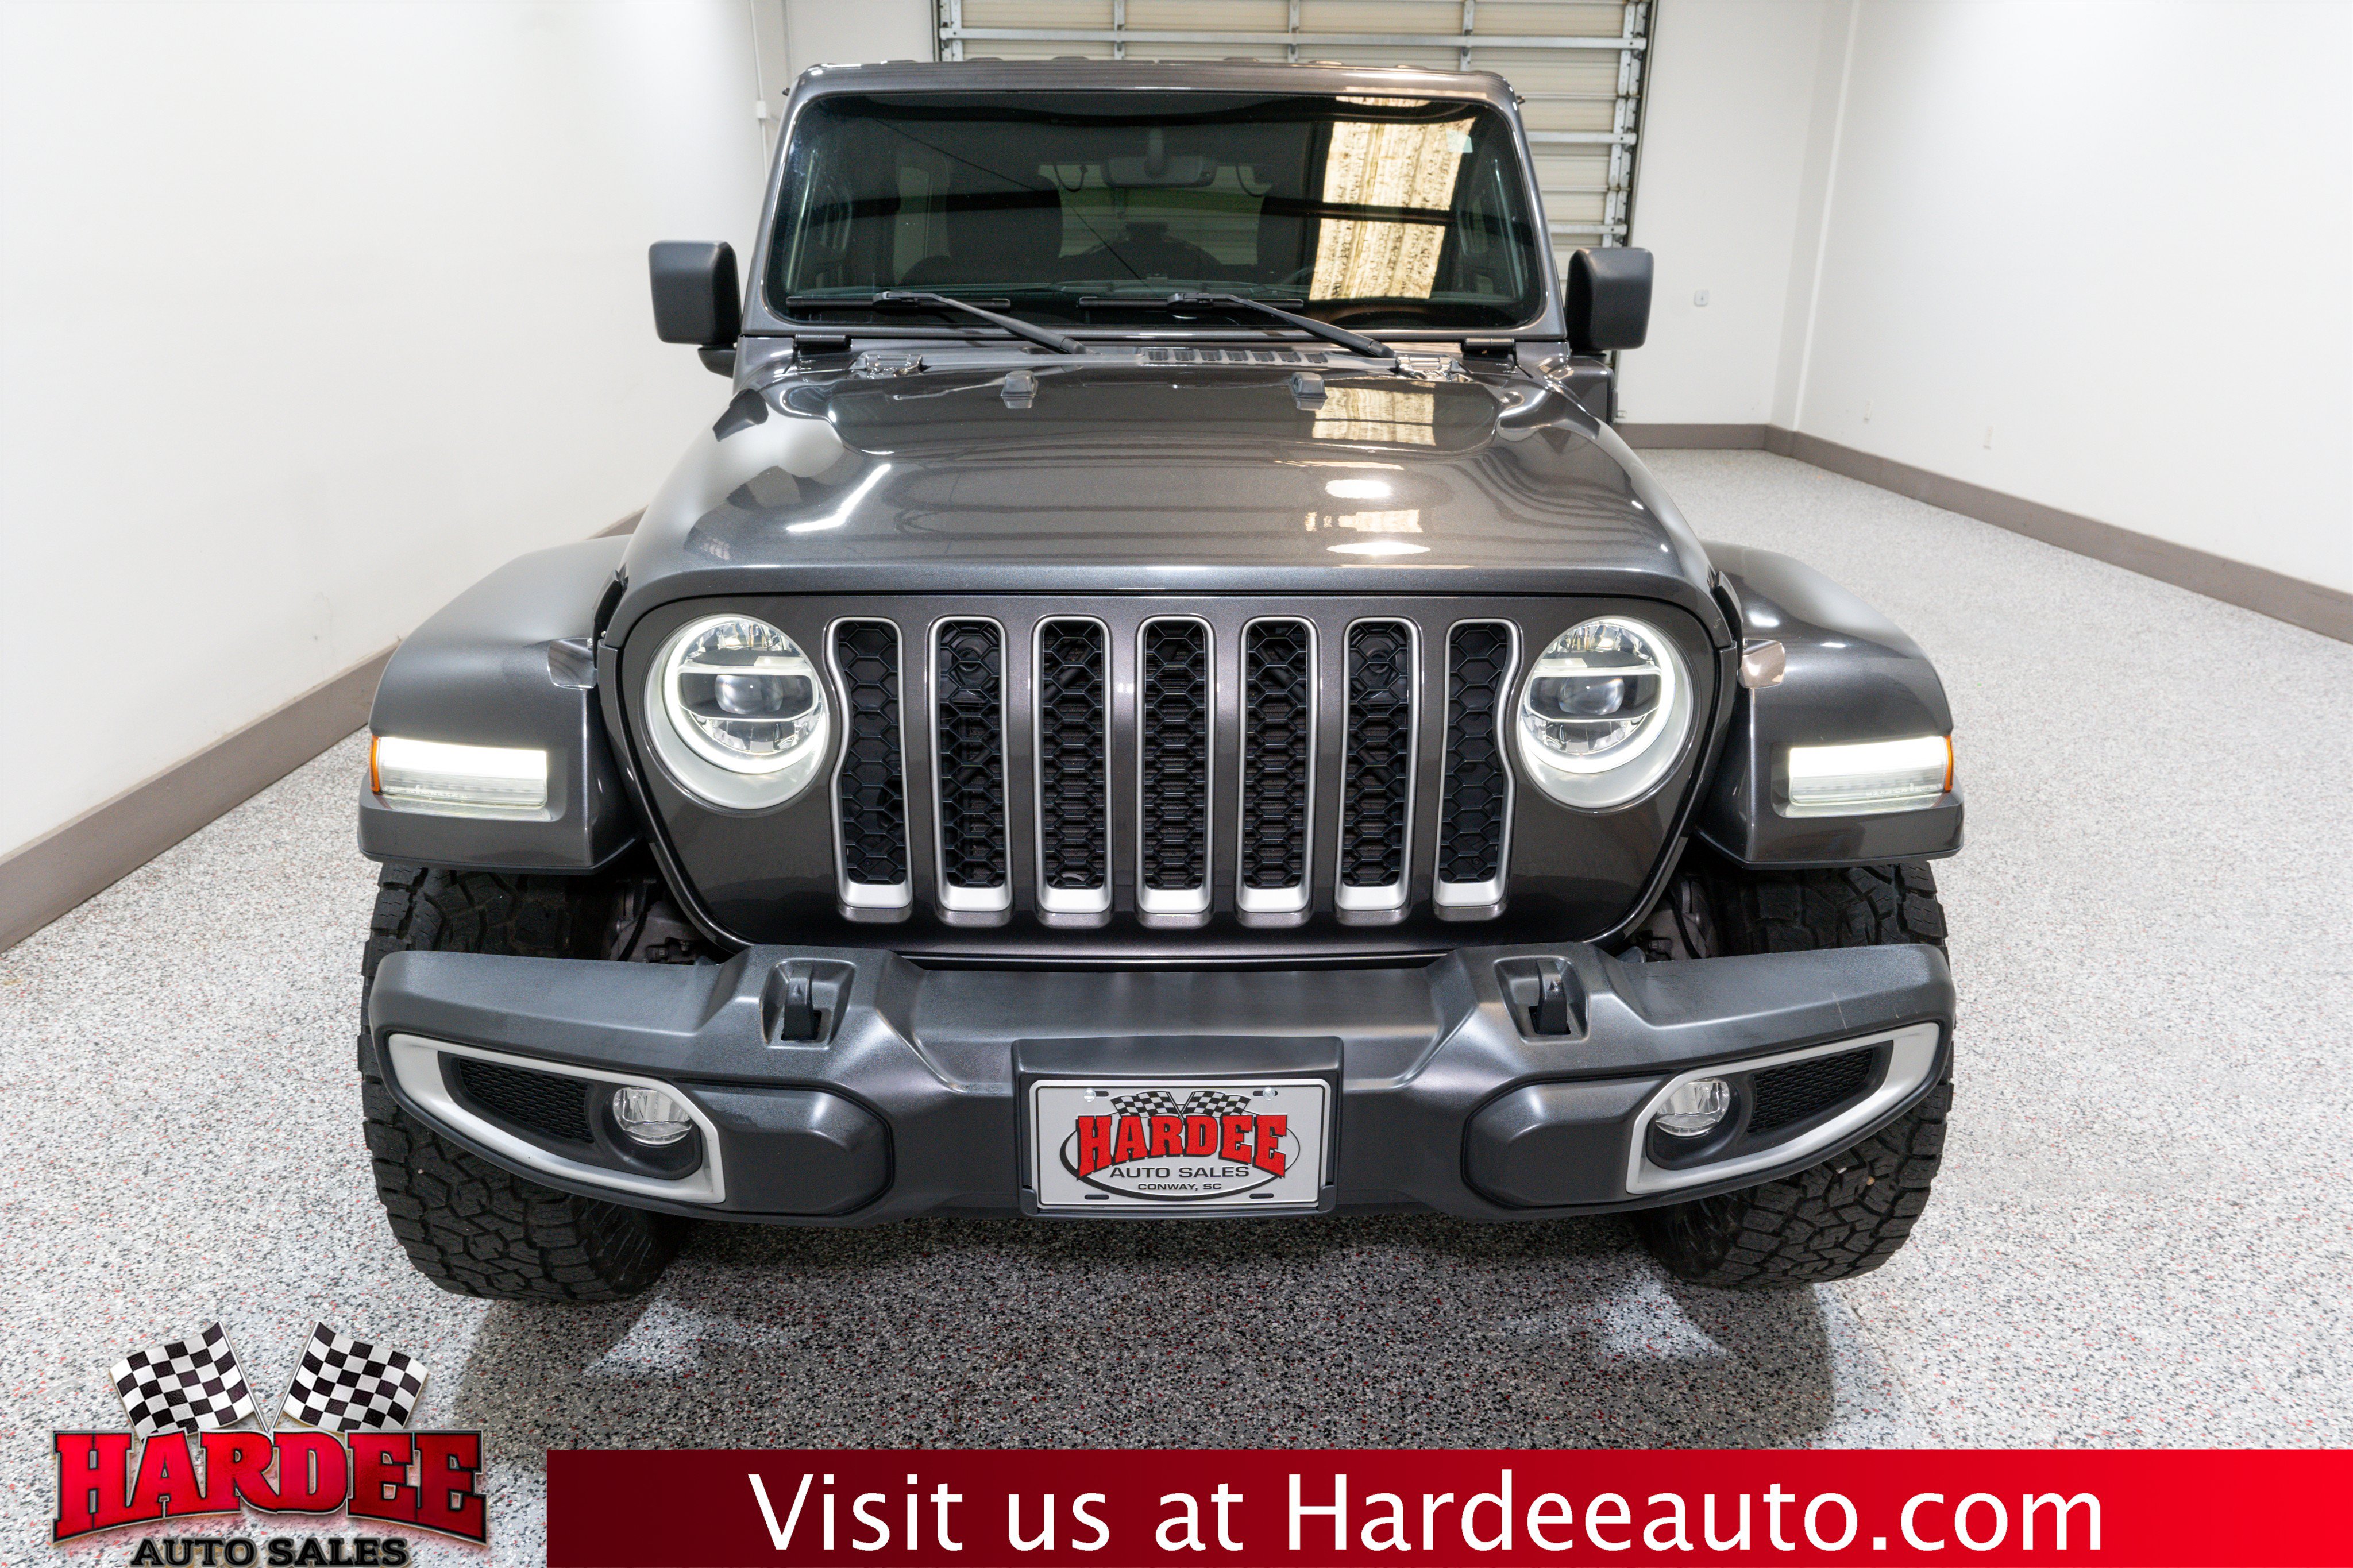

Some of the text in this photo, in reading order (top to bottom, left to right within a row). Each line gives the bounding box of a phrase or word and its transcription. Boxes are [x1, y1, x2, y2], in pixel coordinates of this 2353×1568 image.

[1075, 1114, 1287, 1179] HARDEE
[1109, 1166, 1249, 1178] AUTO SALES
[1137, 1183, 1198, 1191] CONWAY,
